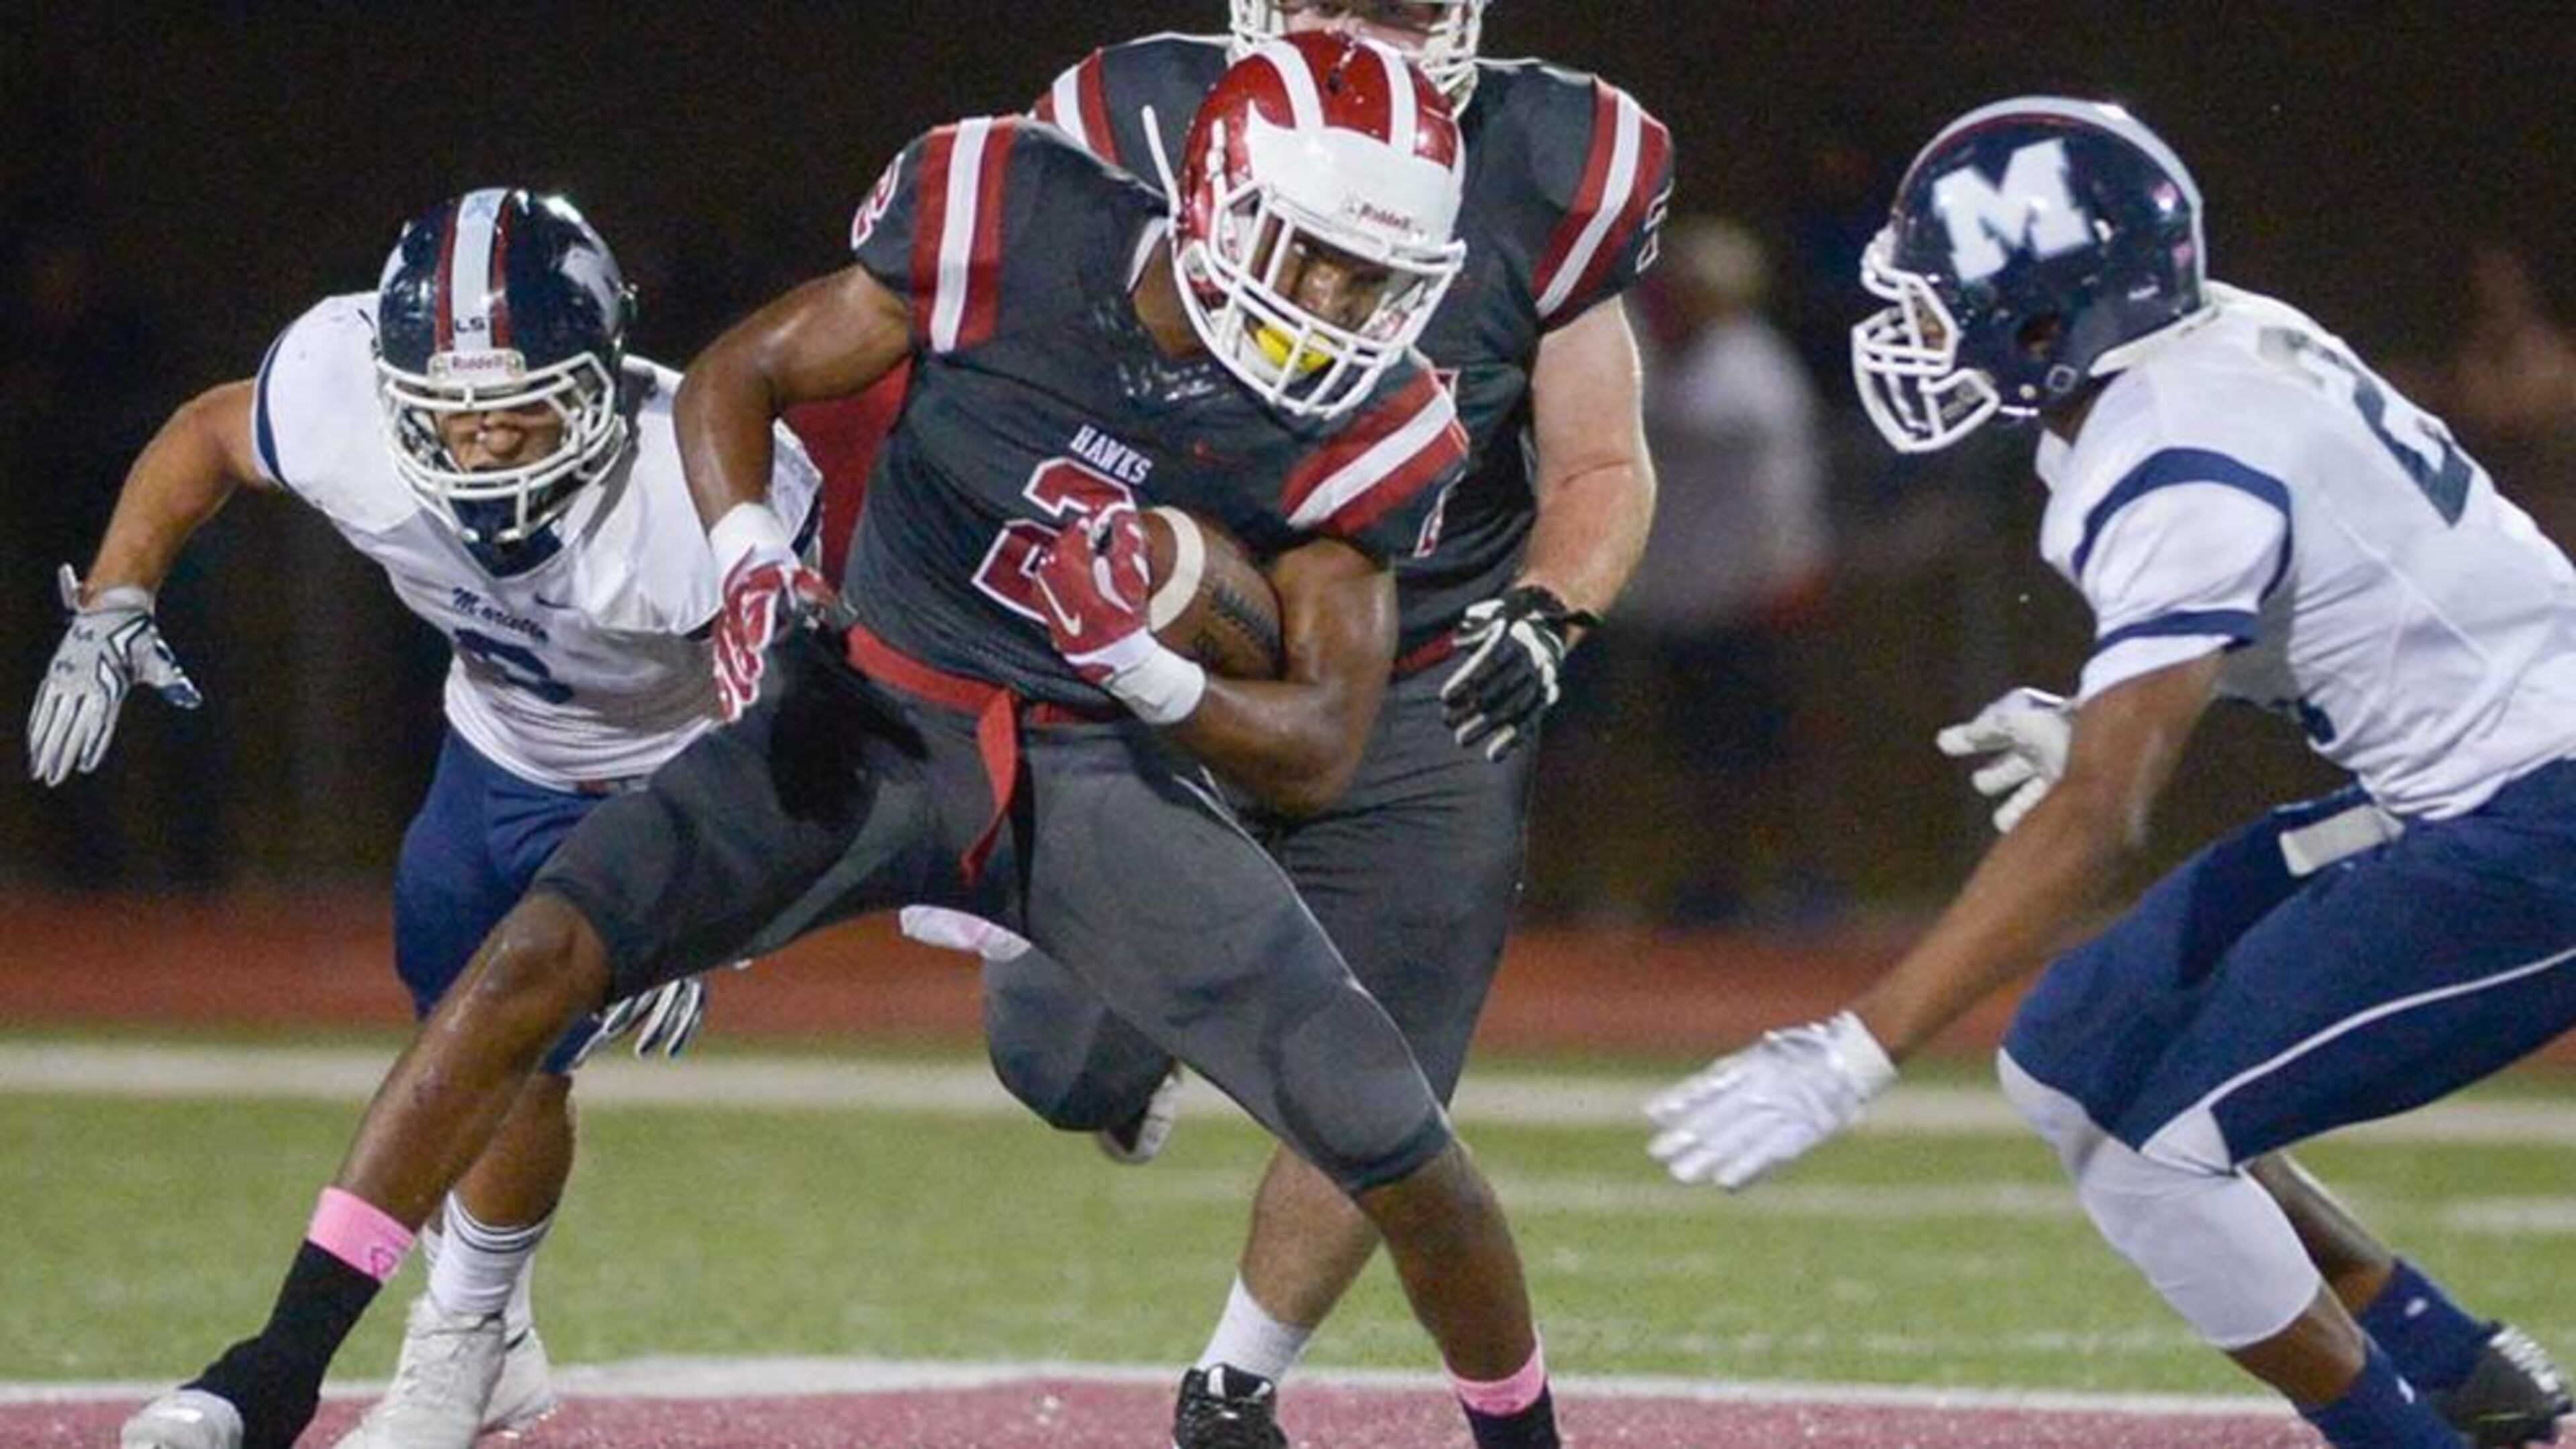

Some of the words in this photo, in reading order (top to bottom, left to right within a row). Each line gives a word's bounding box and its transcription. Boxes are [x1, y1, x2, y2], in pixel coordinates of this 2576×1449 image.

[1932, 138, 2094, 284] M
[454, 316, 485, 333] LS
[1069, 423, 1153, 484] HAWKS
